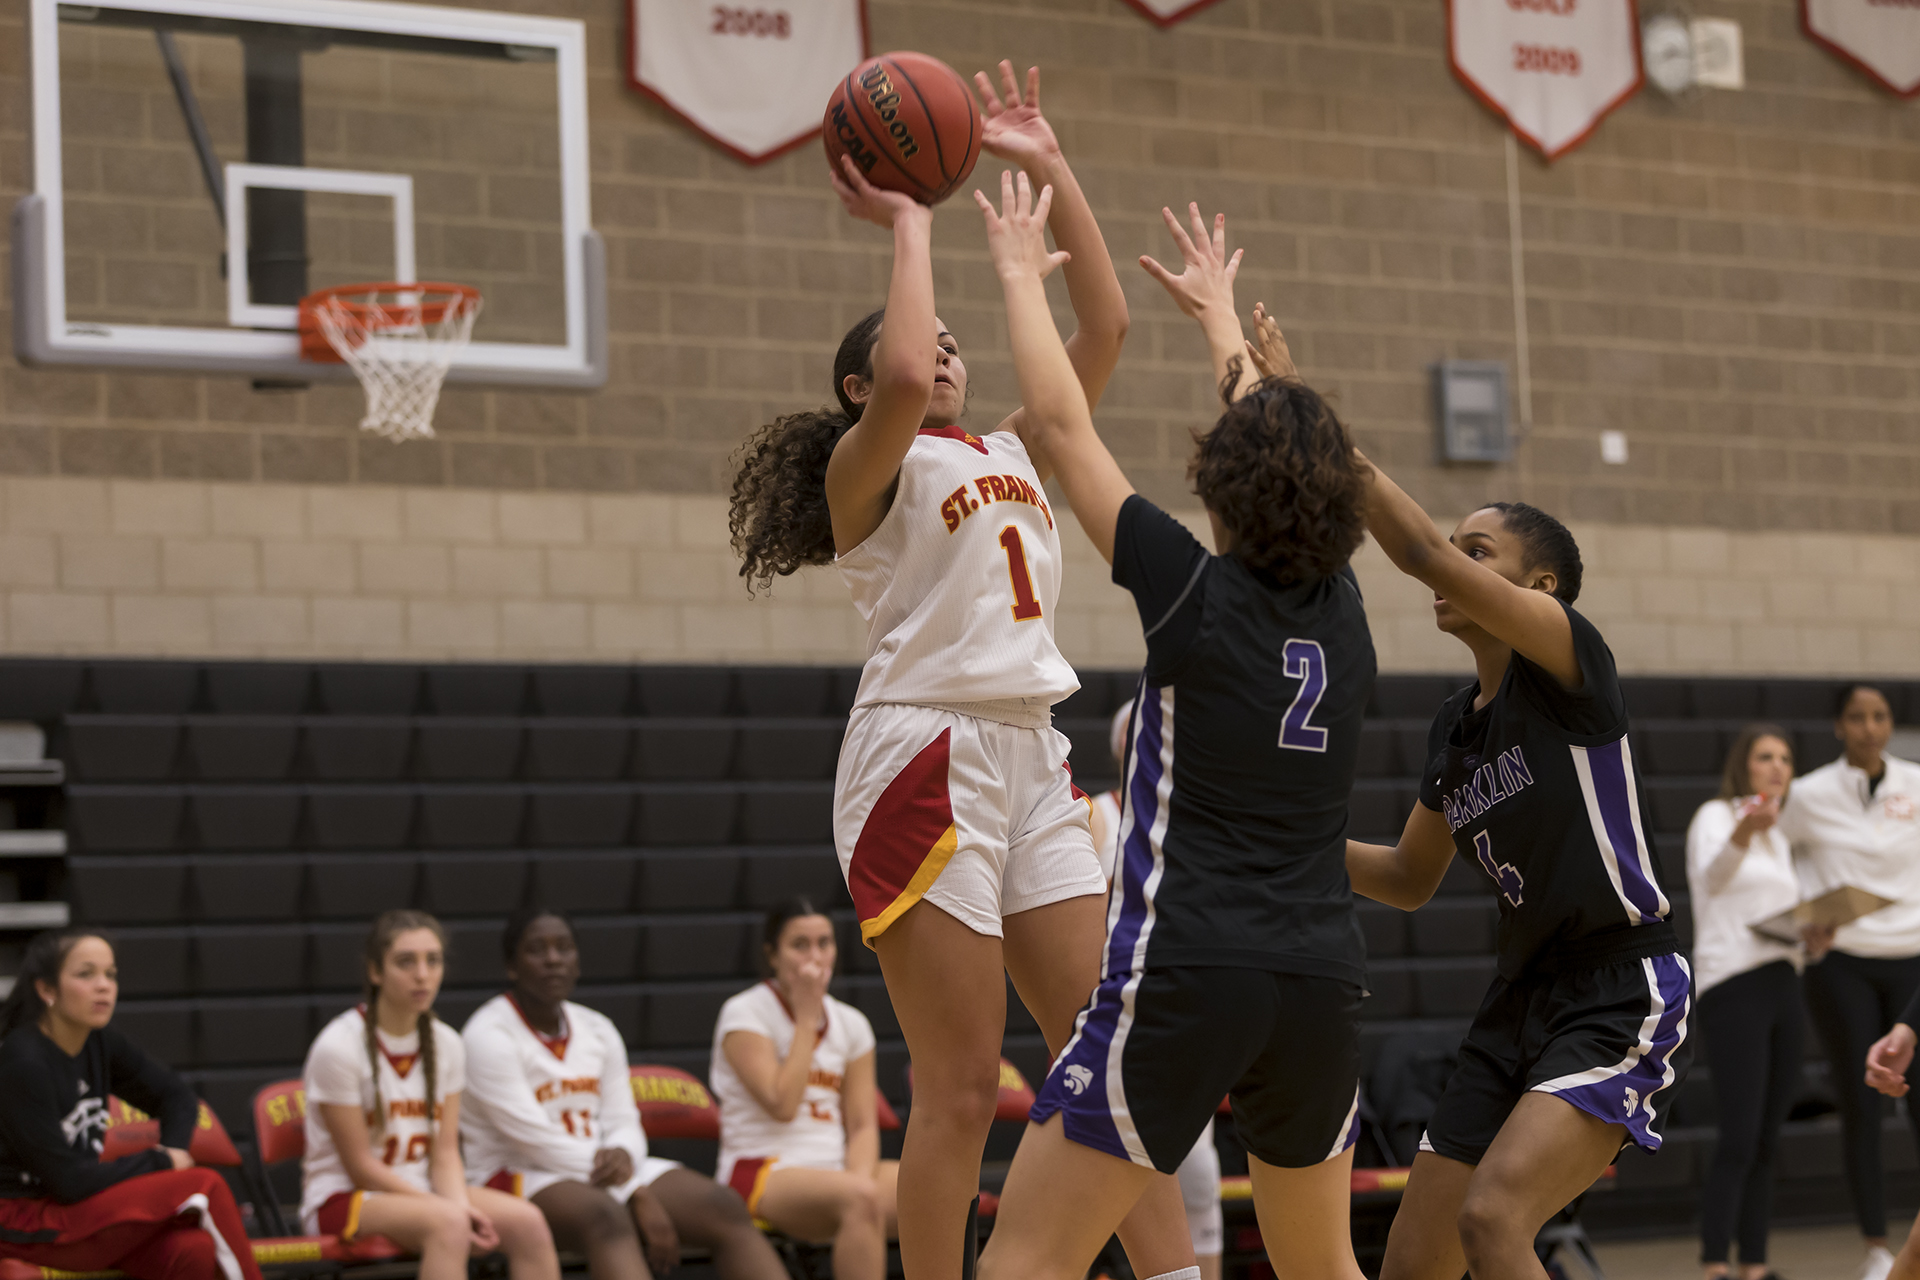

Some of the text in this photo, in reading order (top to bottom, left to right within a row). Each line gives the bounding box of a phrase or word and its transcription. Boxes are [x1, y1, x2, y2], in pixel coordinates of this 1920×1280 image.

[711, 5, 791, 39] 2008
[1512, 43, 1582, 76] 2009
[831, 100, 878, 172] NCAA
[858, 62, 920, 161] Wilson
[941, 484, 979, 535] ST.
[998, 525, 1043, 623] 1
[1278, 638, 1328, 753] 2
[1442, 745, 1534, 834] RANKLIN
[1473, 828, 1524, 908] 4
